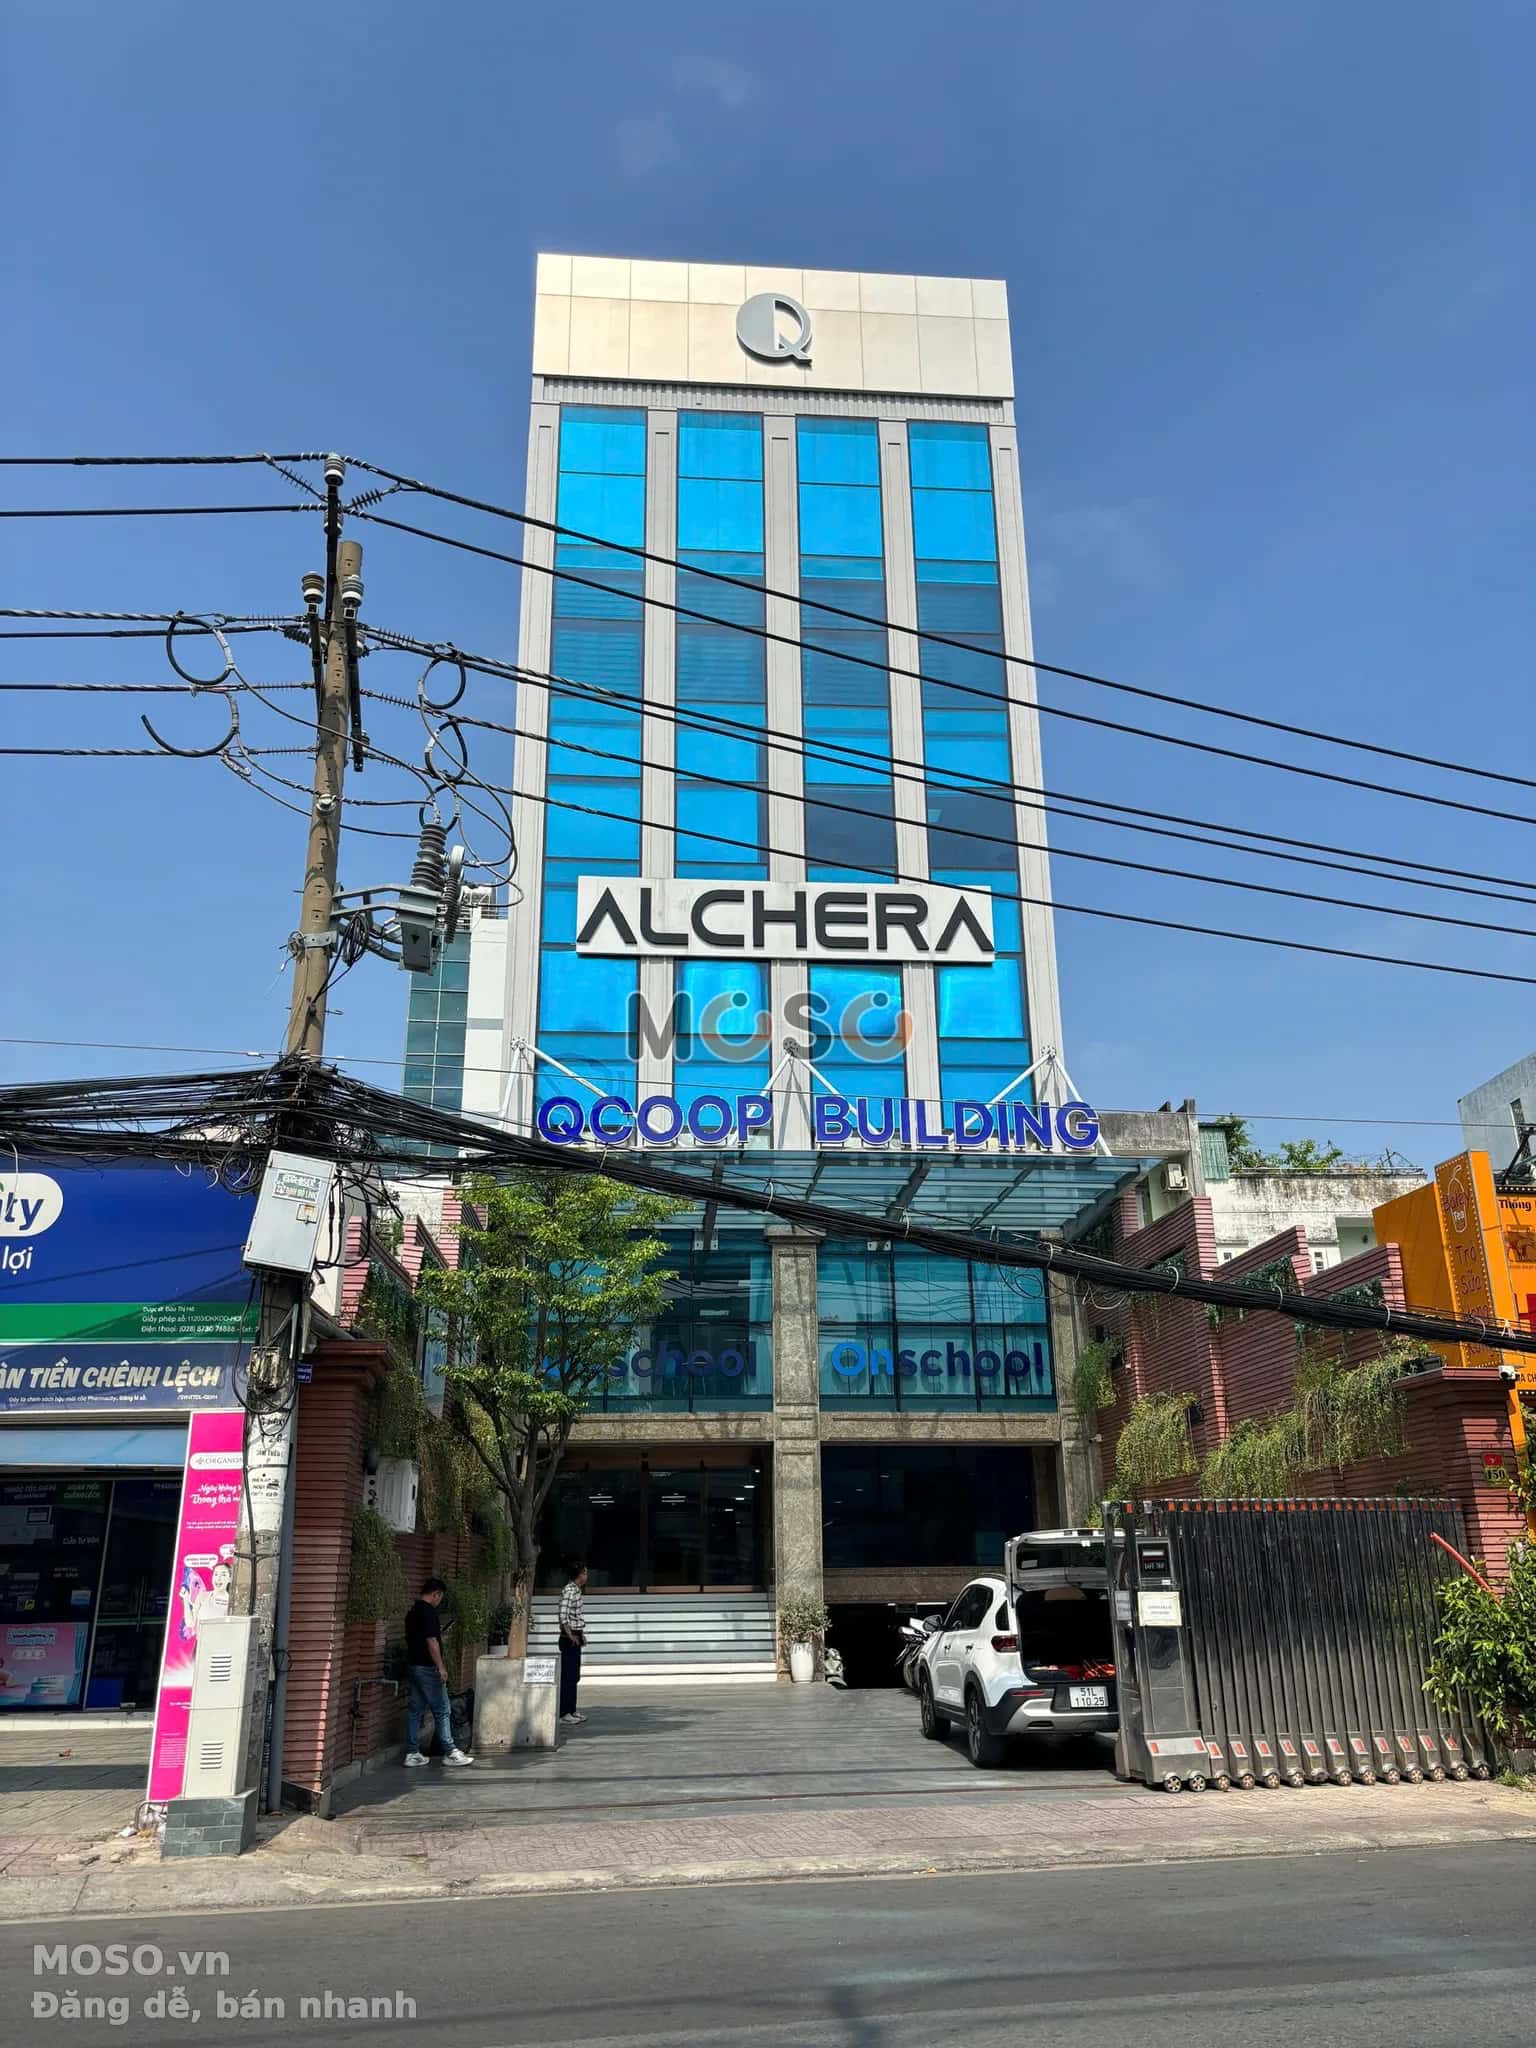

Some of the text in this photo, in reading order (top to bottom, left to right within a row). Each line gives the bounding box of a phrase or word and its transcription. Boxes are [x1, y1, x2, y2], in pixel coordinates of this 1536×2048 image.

[577, 886, 995, 951] ALCHERA
[537, 1095, 1099, 1148] QCOOP BUILDING
[2, 1245, 33, 1275] lợi
[30, 1357, 81, 1388] TIỀN
[82, 1360, 160, 1388] CHÊNH
[162, 1360, 222, 1392] LỆCH
[831, 1341, 1044, 1377] Onschool
[1080, 1687, 1097, 1697] 51L
